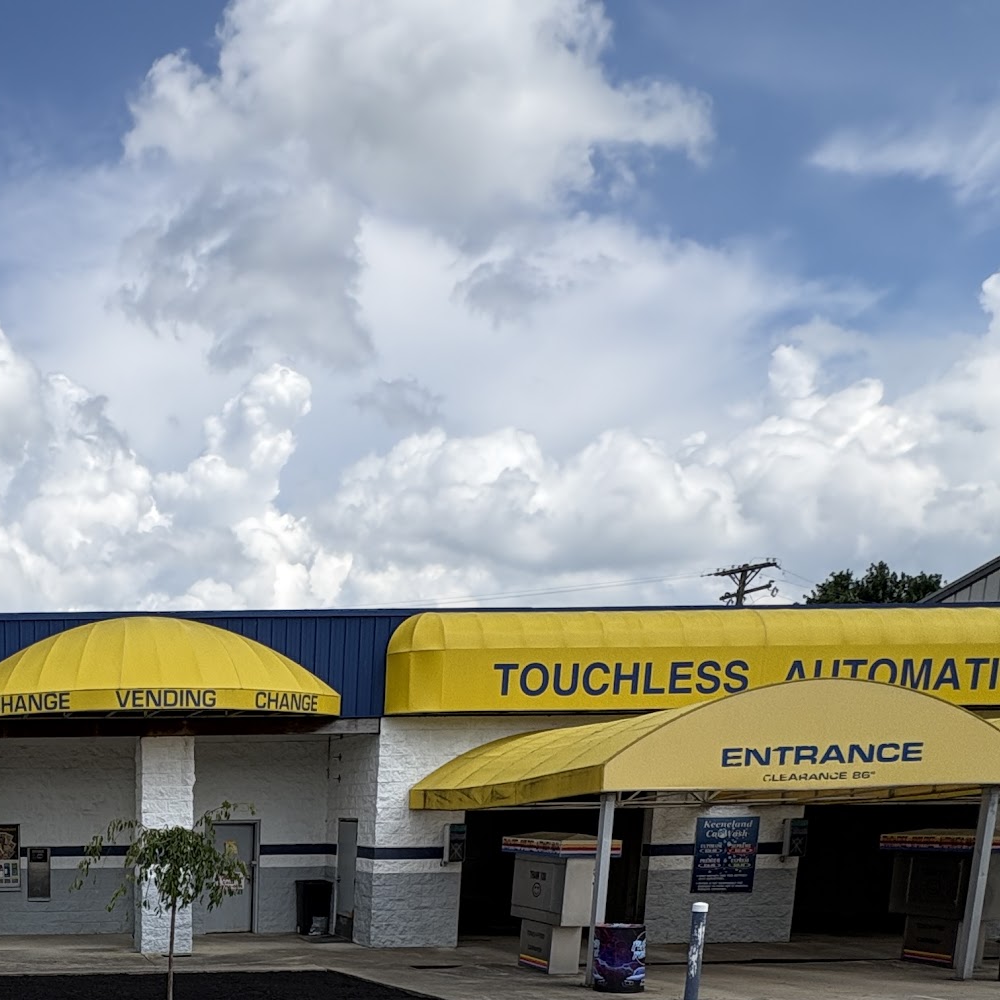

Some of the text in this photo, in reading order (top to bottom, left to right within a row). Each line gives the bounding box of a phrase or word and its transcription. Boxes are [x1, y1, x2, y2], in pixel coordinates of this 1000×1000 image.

[494, 659, 750, 696] TOUCHLESS
[115, 688, 217, 708] VENDING
[254, 691, 318, 713] CHANGE
[722, 742, 924, 768] ENTRANCE
[763, 771, 848, 783] CLEARANCE
[704, 820, 754, 829] Keeneland
